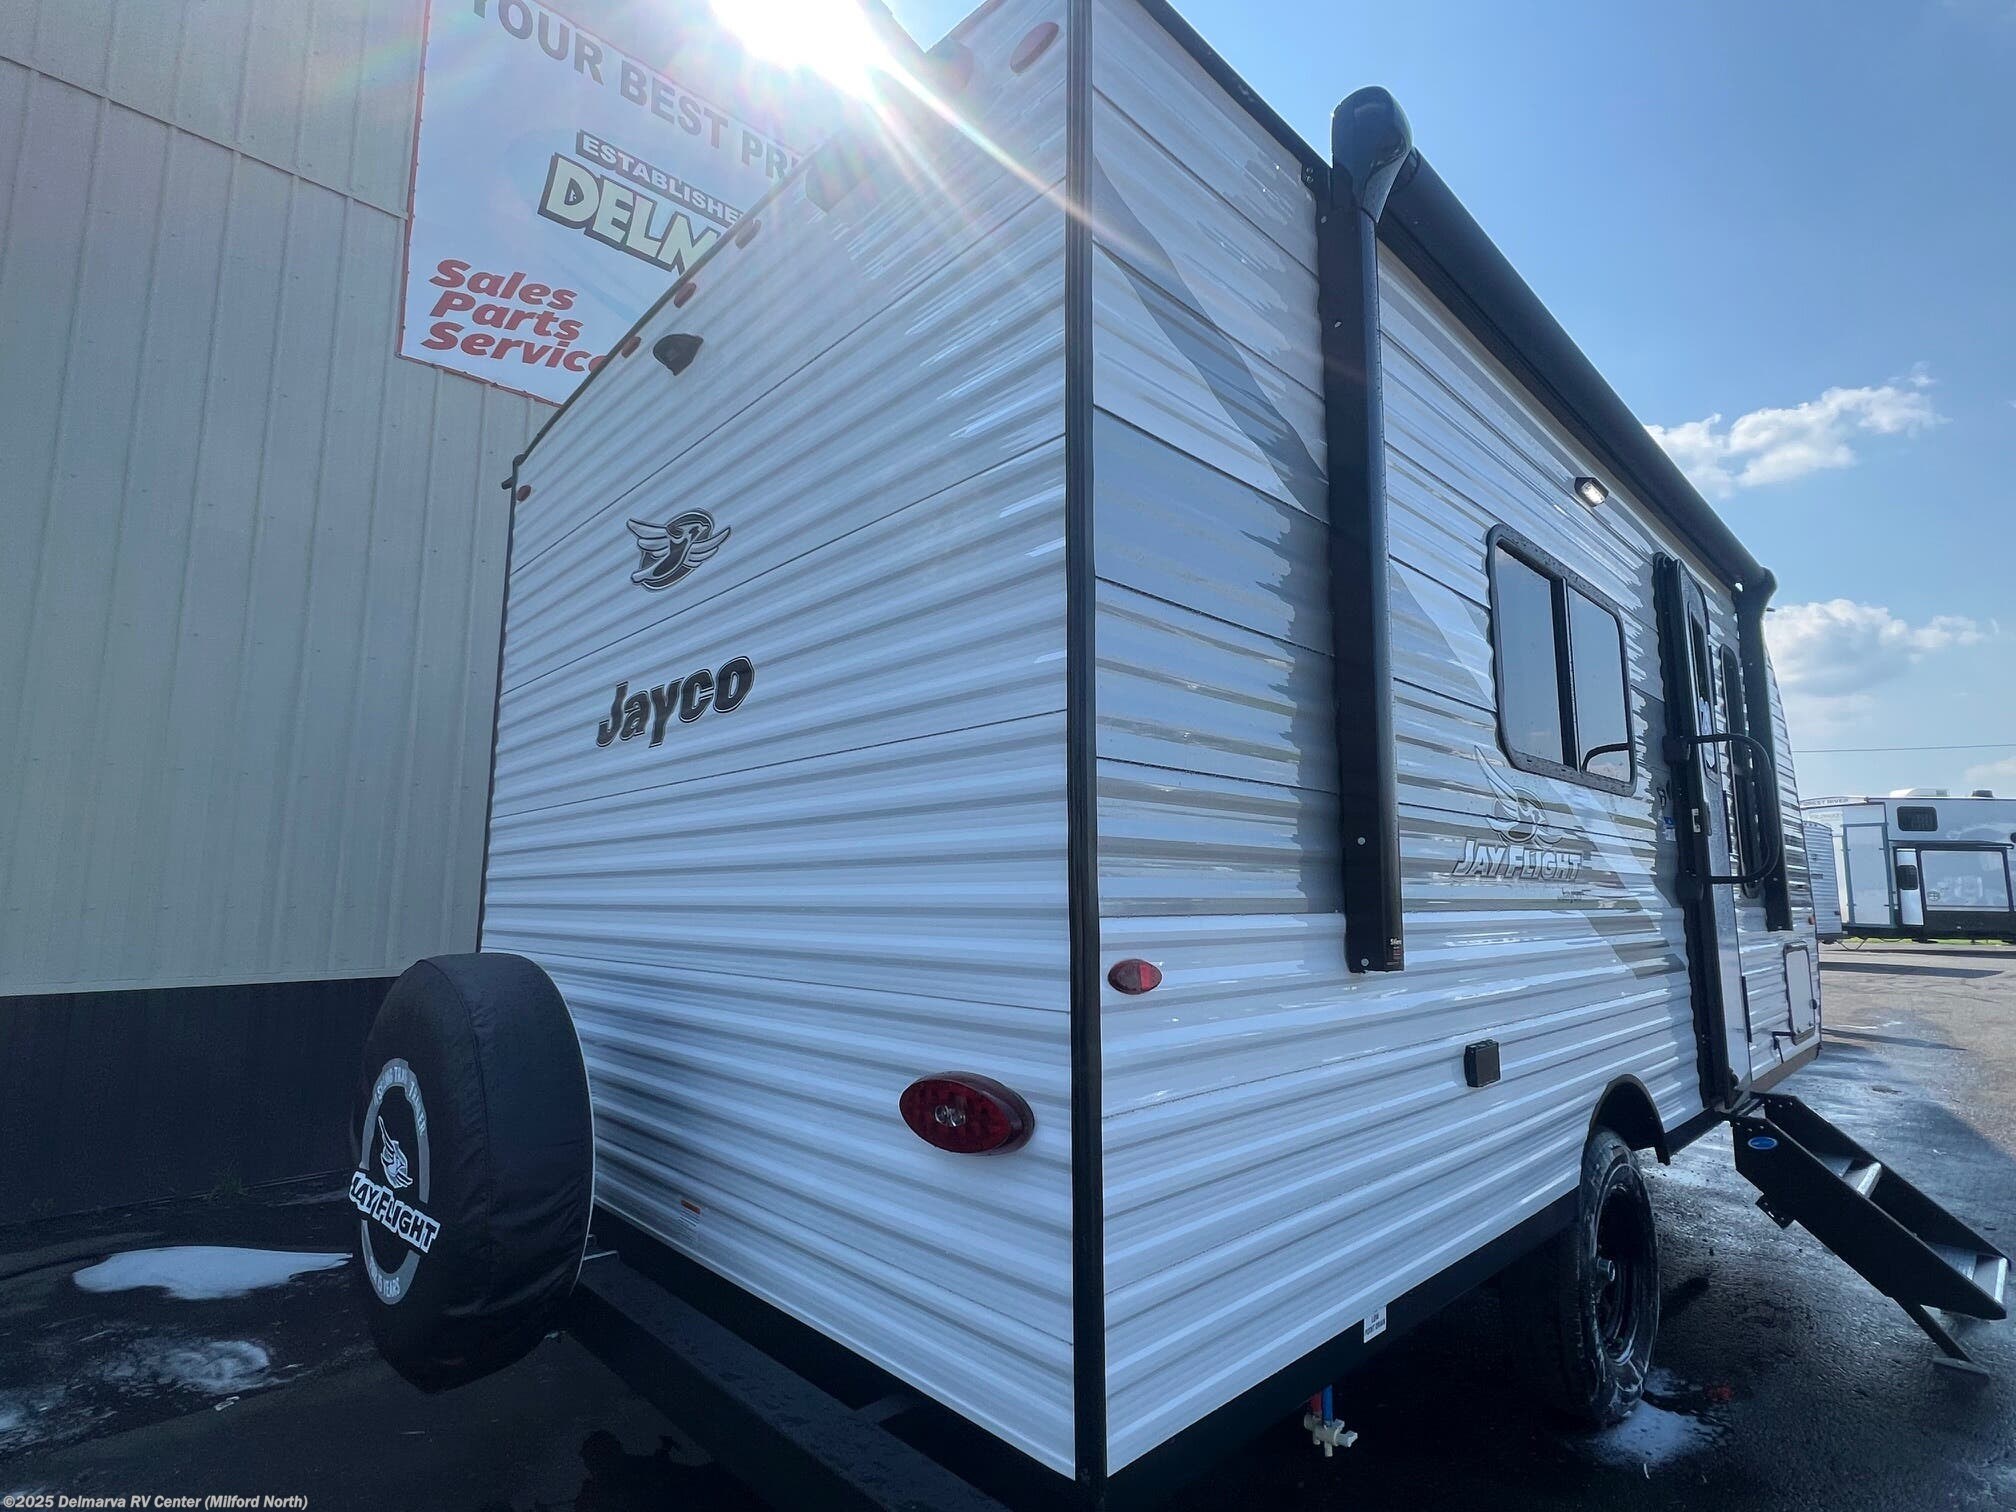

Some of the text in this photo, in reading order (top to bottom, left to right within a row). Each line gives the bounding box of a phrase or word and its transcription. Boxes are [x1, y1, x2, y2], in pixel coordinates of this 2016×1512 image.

[620, 59, 729, 149] BEST
[741, 129, 799, 179] PR
[581, 133, 744, 227] ESTABLISHE
[429, 259, 578, 310] Sales
[429, 290, 584, 341] Parts
[596, 656, 755, 749] Jayco
